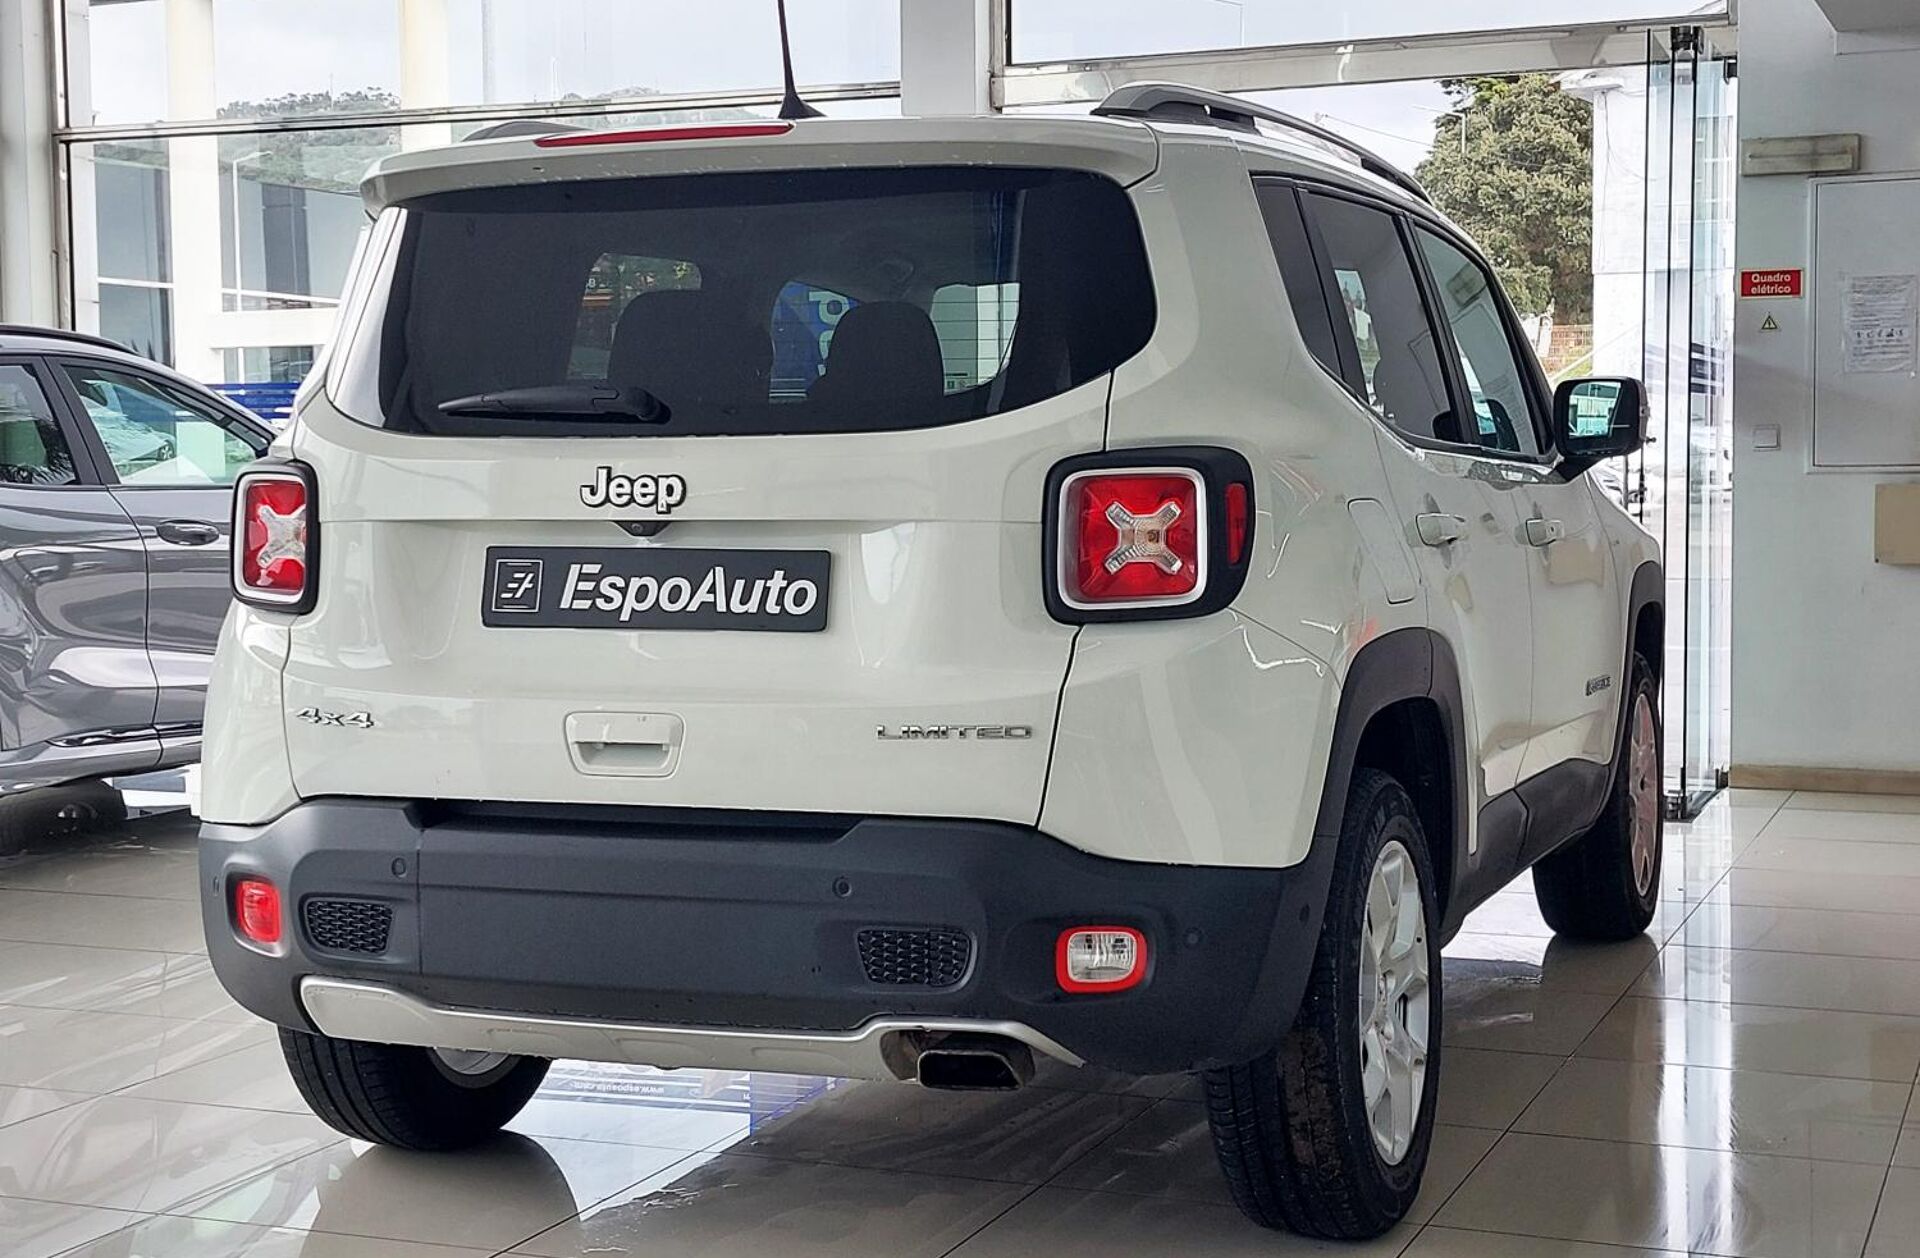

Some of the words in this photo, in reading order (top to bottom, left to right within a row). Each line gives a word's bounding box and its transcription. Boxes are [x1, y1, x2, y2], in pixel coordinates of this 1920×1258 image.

[1751, 273, 1791, 283] Quadro
[1750, 284, 1791, 294] elétrico
[580, 466, 687, 515] Jeep
[559, 563, 818, 622] EspoAuto
[297, 707, 375, 729] 4x4
[876, 724, 1033, 740] LIMITED
